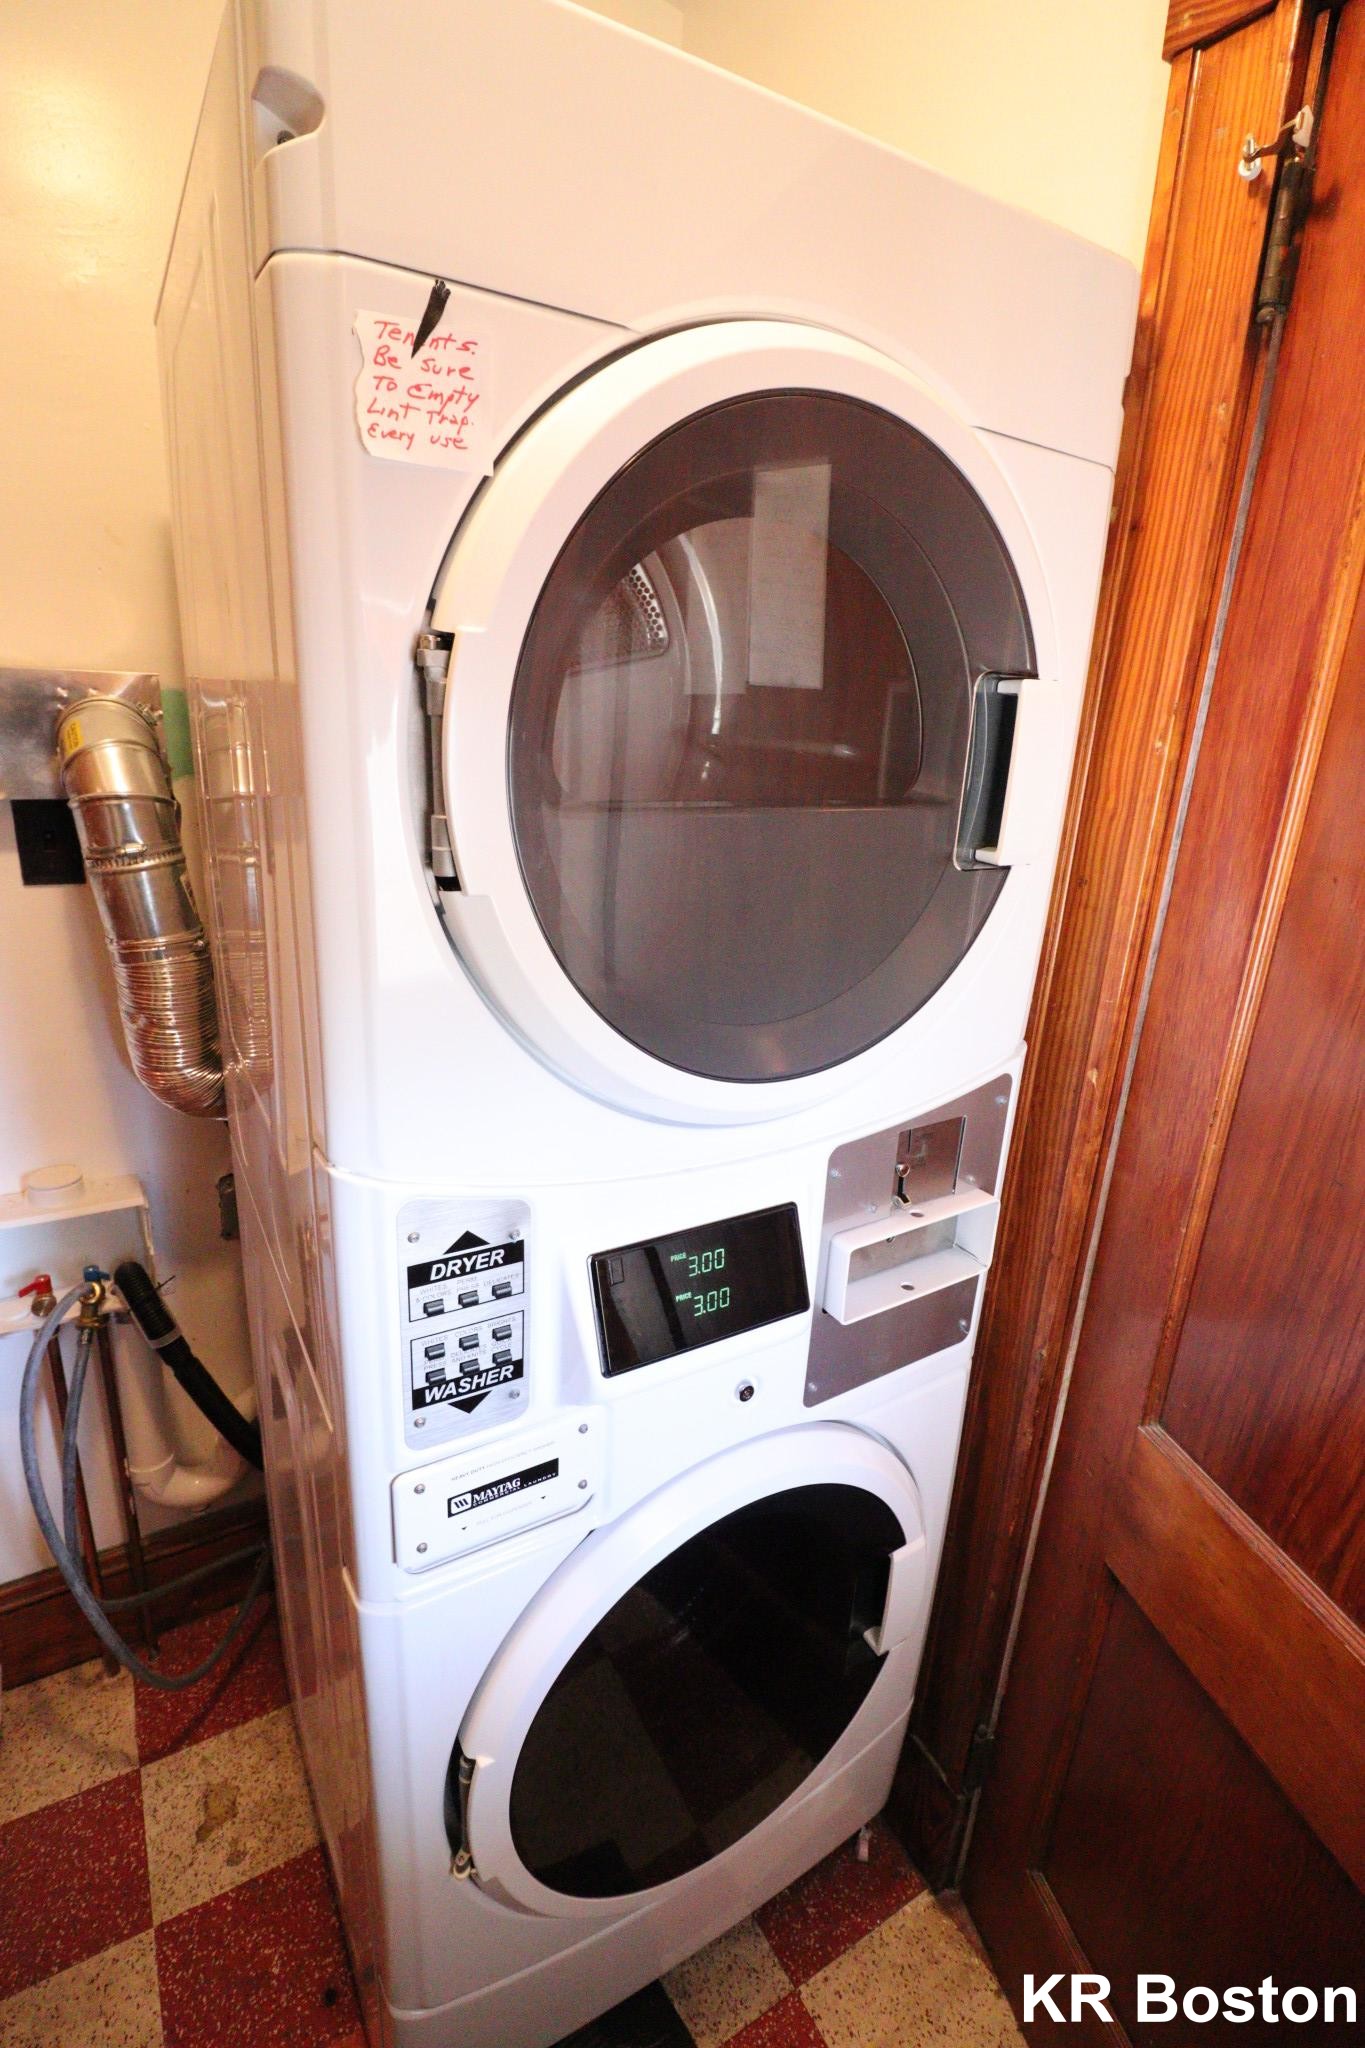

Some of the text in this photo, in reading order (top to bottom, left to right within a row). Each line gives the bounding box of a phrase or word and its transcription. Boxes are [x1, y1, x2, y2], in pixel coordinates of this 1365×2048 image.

[373, 345, 402, 369] Be
[406, 383, 480, 416] Empty
[367, 422, 415, 450] Every
[429, 1248, 505, 1281] DRYER
[689, 1248, 725, 1277] 3.00
[675, 1292, 692, 1302] PRICE
[694, 1287, 730, 1317] 3.00
[424, 1364, 514, 1404] WASHER
[473, 1477, 521, 1503] MAYTAG
[523, 1472, 556, 1488] LAUNDRY
